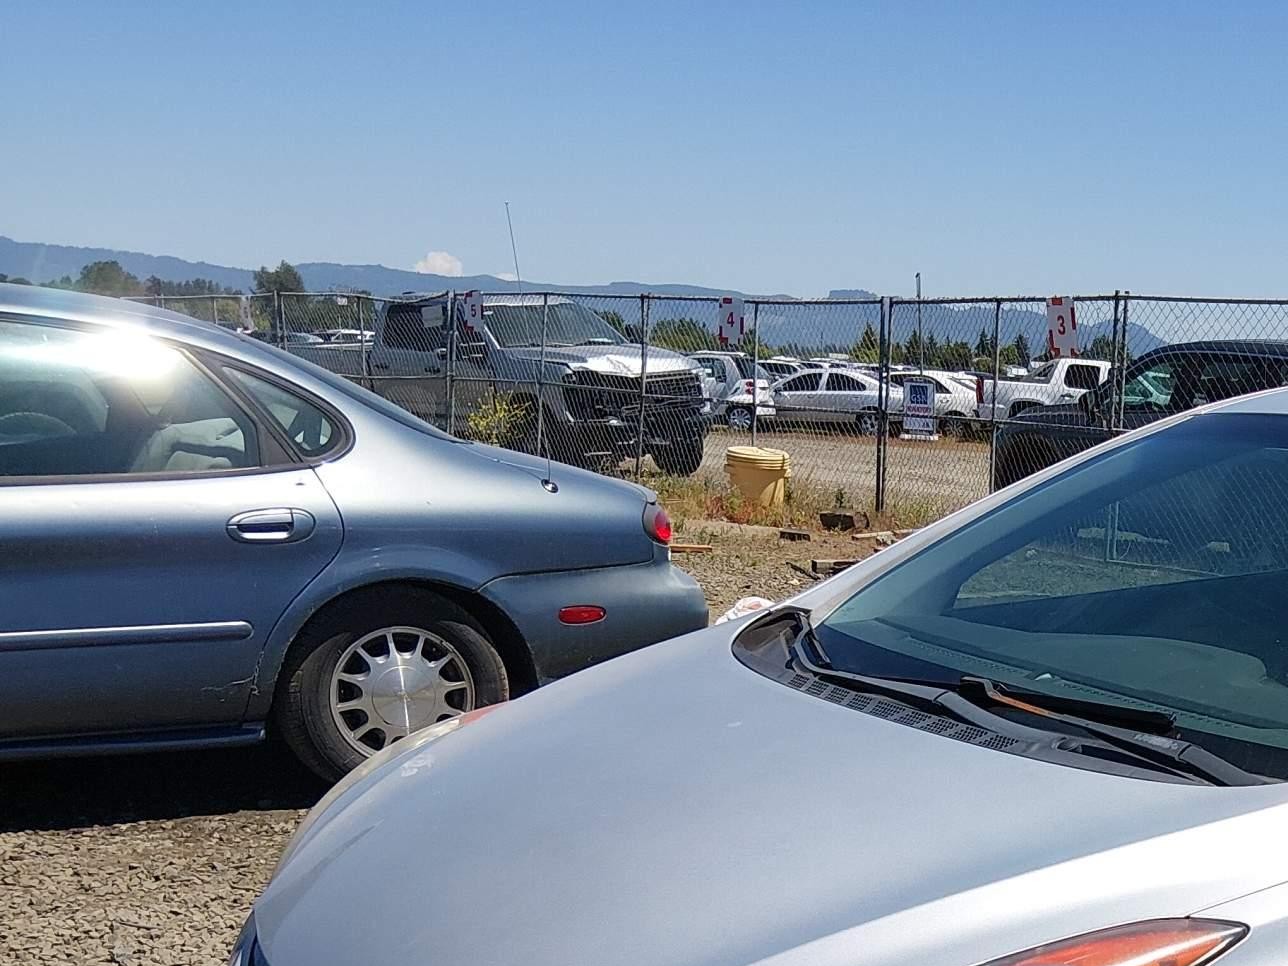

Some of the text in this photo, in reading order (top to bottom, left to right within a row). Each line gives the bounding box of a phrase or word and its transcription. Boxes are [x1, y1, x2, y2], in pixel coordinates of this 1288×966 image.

[470, 303, 477, 318] 5
[726, 311, 735, 328] 4
[1057, 314, 1066, 335] 3
